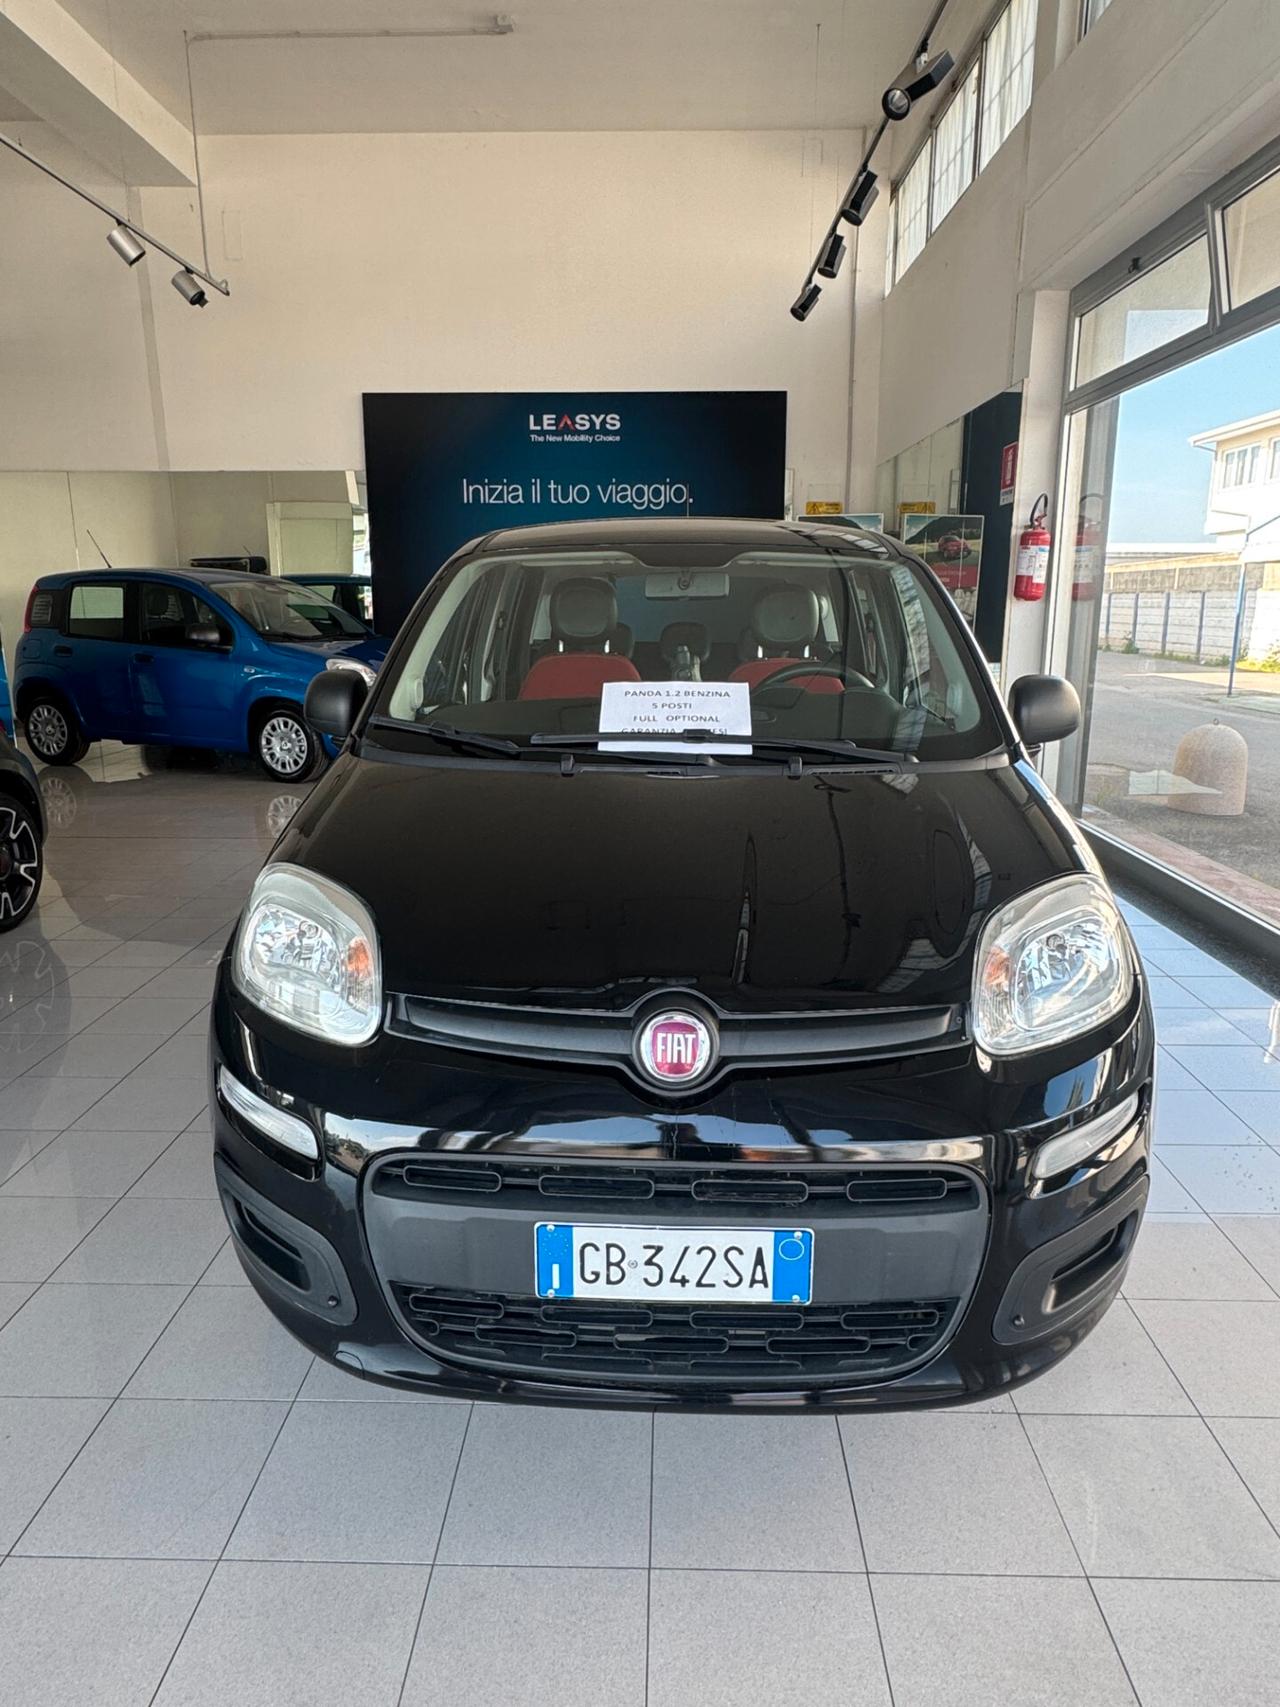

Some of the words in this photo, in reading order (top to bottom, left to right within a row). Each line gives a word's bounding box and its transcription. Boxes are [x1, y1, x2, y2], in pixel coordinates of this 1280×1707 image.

[529, 414, 621, 431] LEASYS
[530, 434, 544, 442] The
[546, 434, 562, 442] New
[564, 434, 593, 443] Mobility
[595, 434, 620, 442] Choice
[463, 478, 524, 504] Inizia
[532, 478, 540, 504] il
[549, 480, 590, 504] tuo
[597, 478, 693, 511] viaggio.
[657, 1032, 696, 1064] FIAT
